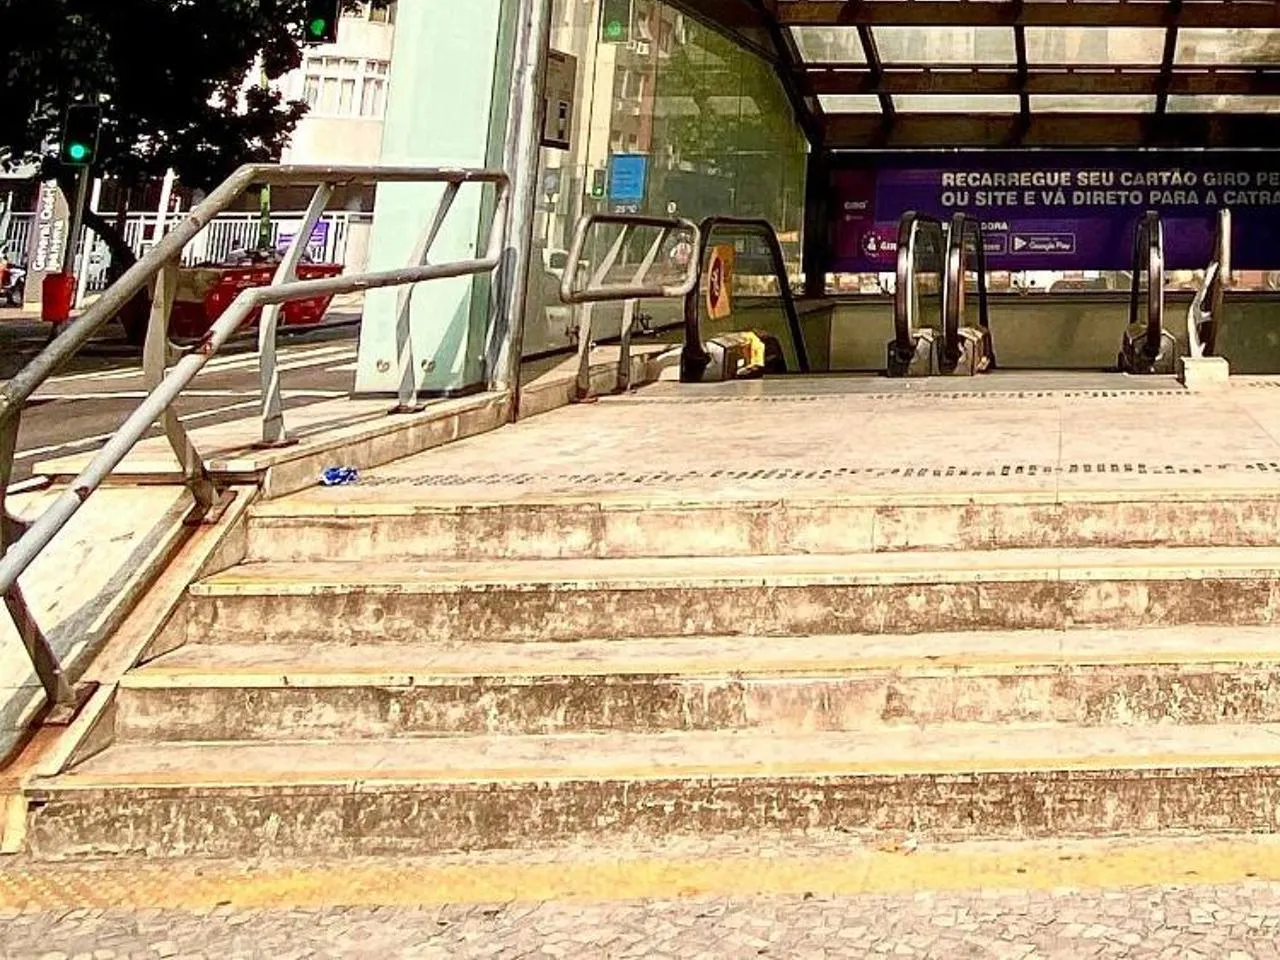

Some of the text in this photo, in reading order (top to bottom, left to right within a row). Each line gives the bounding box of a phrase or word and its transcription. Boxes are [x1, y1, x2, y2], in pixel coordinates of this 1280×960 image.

[941, 172, 1071, 187] RECARREGUE
[1077, 172, 1114, 186] SEU
[1120, 167, 1197, 186] CARTÃO
[1203, 172, 1250, 186] GIRO
[941, 191, 969, 206] OU
[975, 191, 1018, 205] SITE
[1023, 191, 1035, 205] E
[1042, 188, 1066, 205] VÁ
[1072, 191, 1143, 205] DIRETO
[1150, 190, 1199, 205] PARA
[1205, 190, 1217, 205] A
